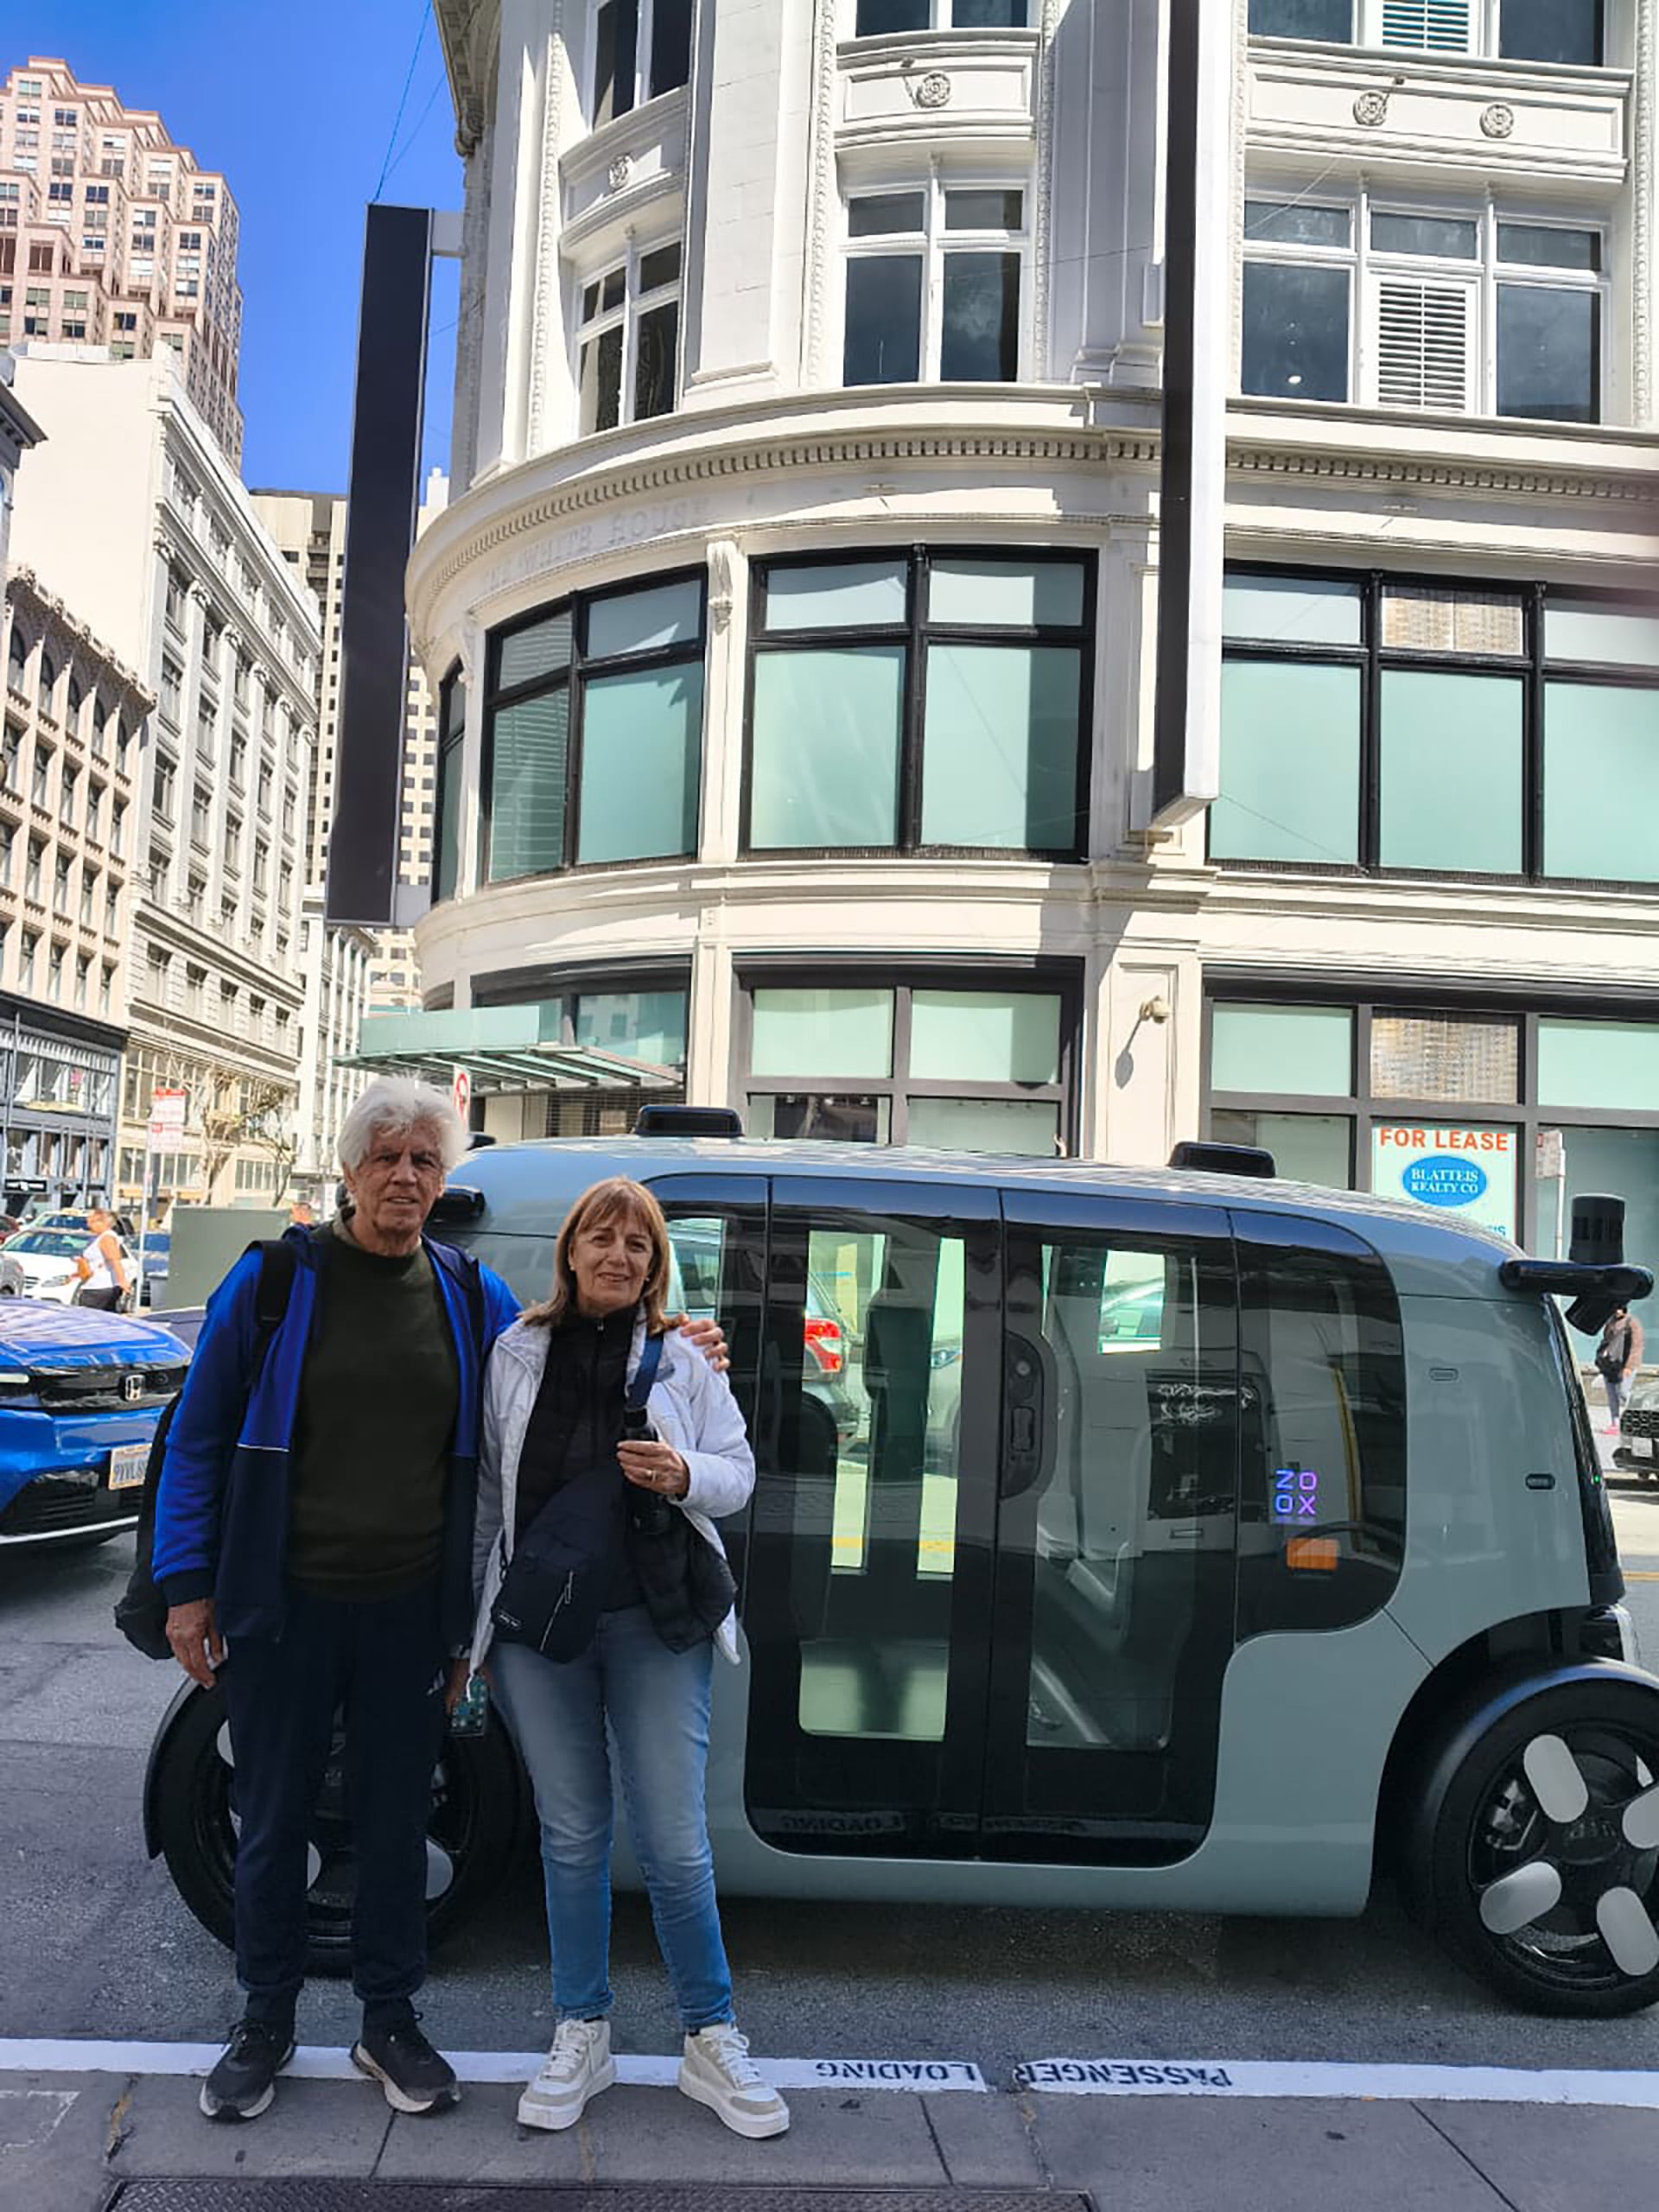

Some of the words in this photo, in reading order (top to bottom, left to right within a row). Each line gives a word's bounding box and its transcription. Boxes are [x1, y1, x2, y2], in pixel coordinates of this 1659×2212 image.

[1380, 1128, 1426, 1147] FOR
[1435, 1130, 1509, 1151] LEASE
[1411, 1168, 1479, 1181] BLATTEIS
[1411, 1181, 1459, 1193] REALTY
[816, 2063, 976, 2082] LOADING
[1014, 2063, 1233, 2087] PASSENGER
